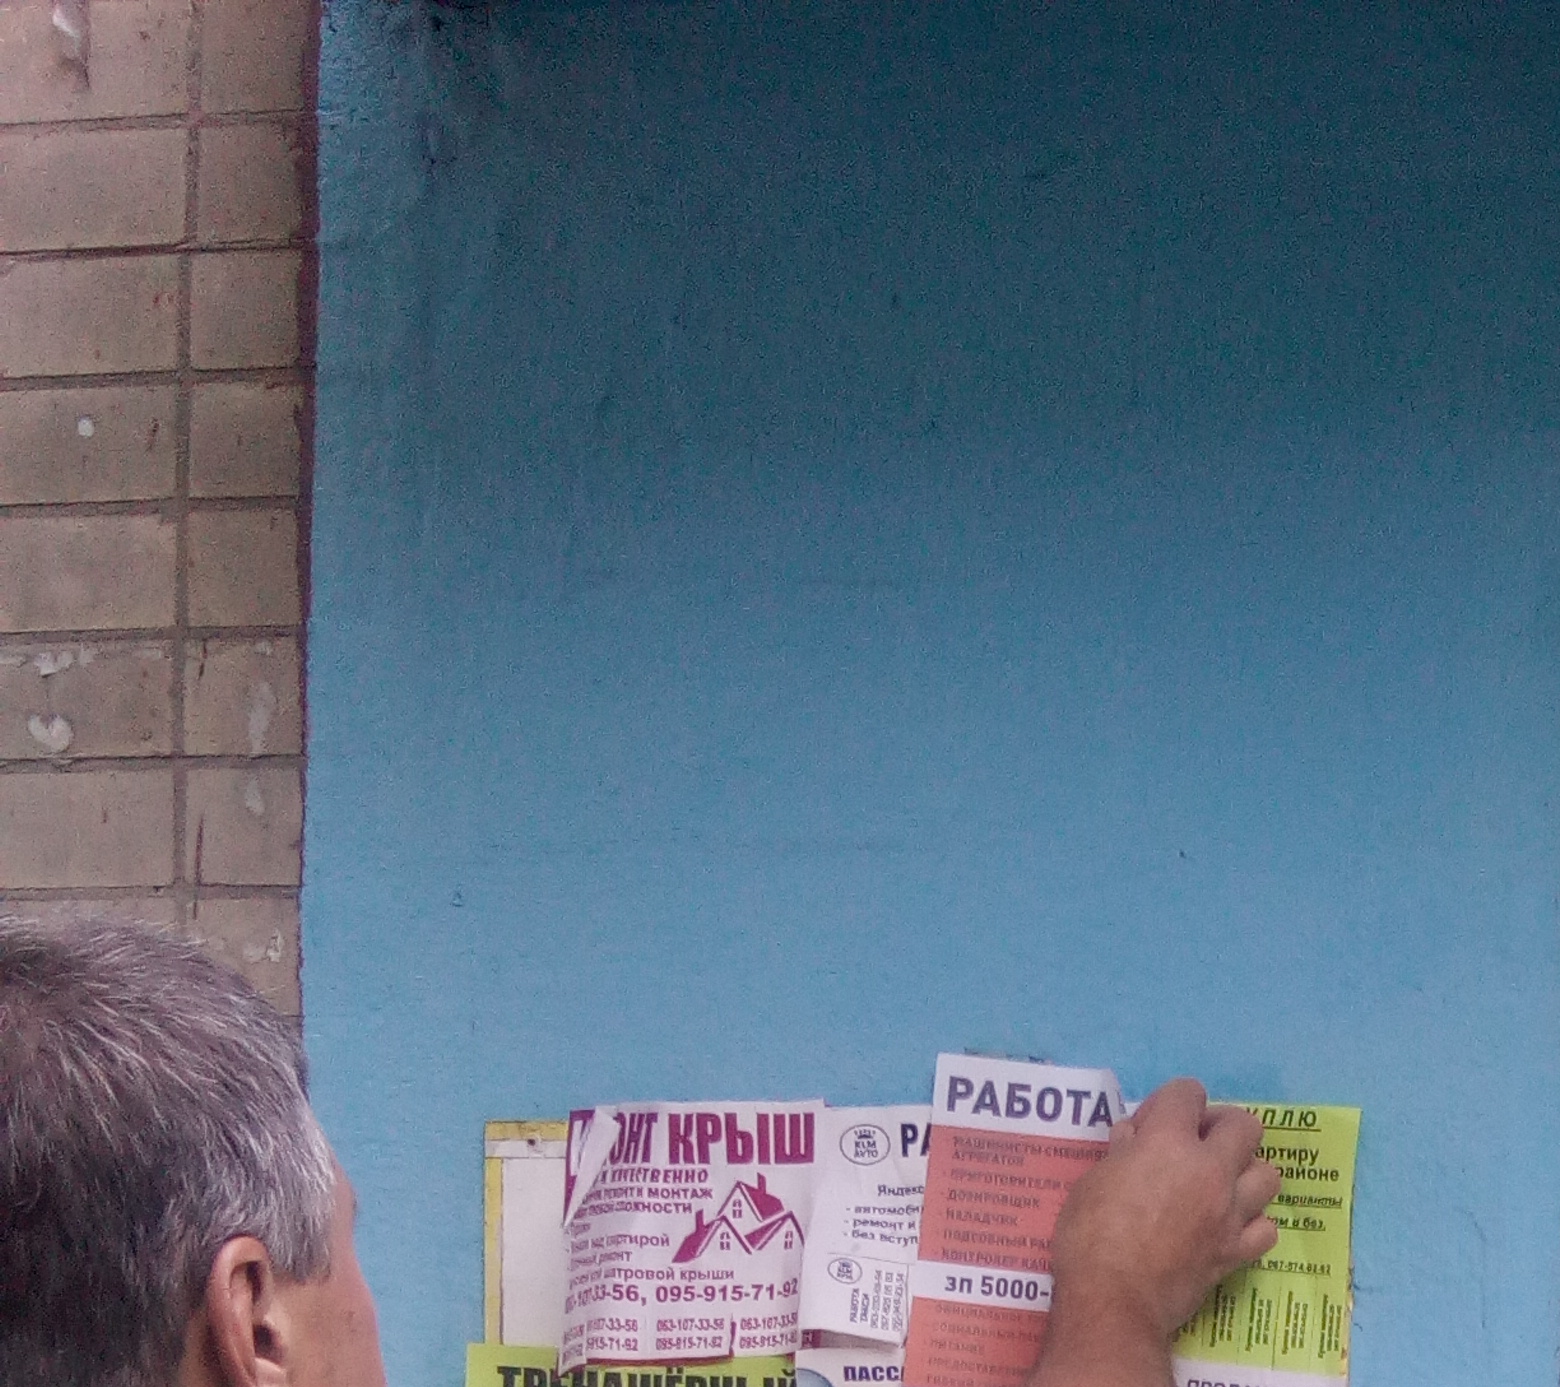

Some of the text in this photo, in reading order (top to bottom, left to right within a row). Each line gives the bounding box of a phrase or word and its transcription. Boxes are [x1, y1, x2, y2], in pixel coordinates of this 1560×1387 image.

[946, 1075, 1113, 1128] РАБОТА
[668, 1112, 815, 1165] КРЫШ
[1254, 1146, 1320, 1165] артиру
[647, 1188, 713, 1200] МОНТАЖ
[680, 1268, 735, 1283] крыши
[655, 1278, 799, 1302] 095-915-71-92
[944, 1275, 1050, 1302] зп 5000-
[844, 1365, 904, 1382] ПАСС
